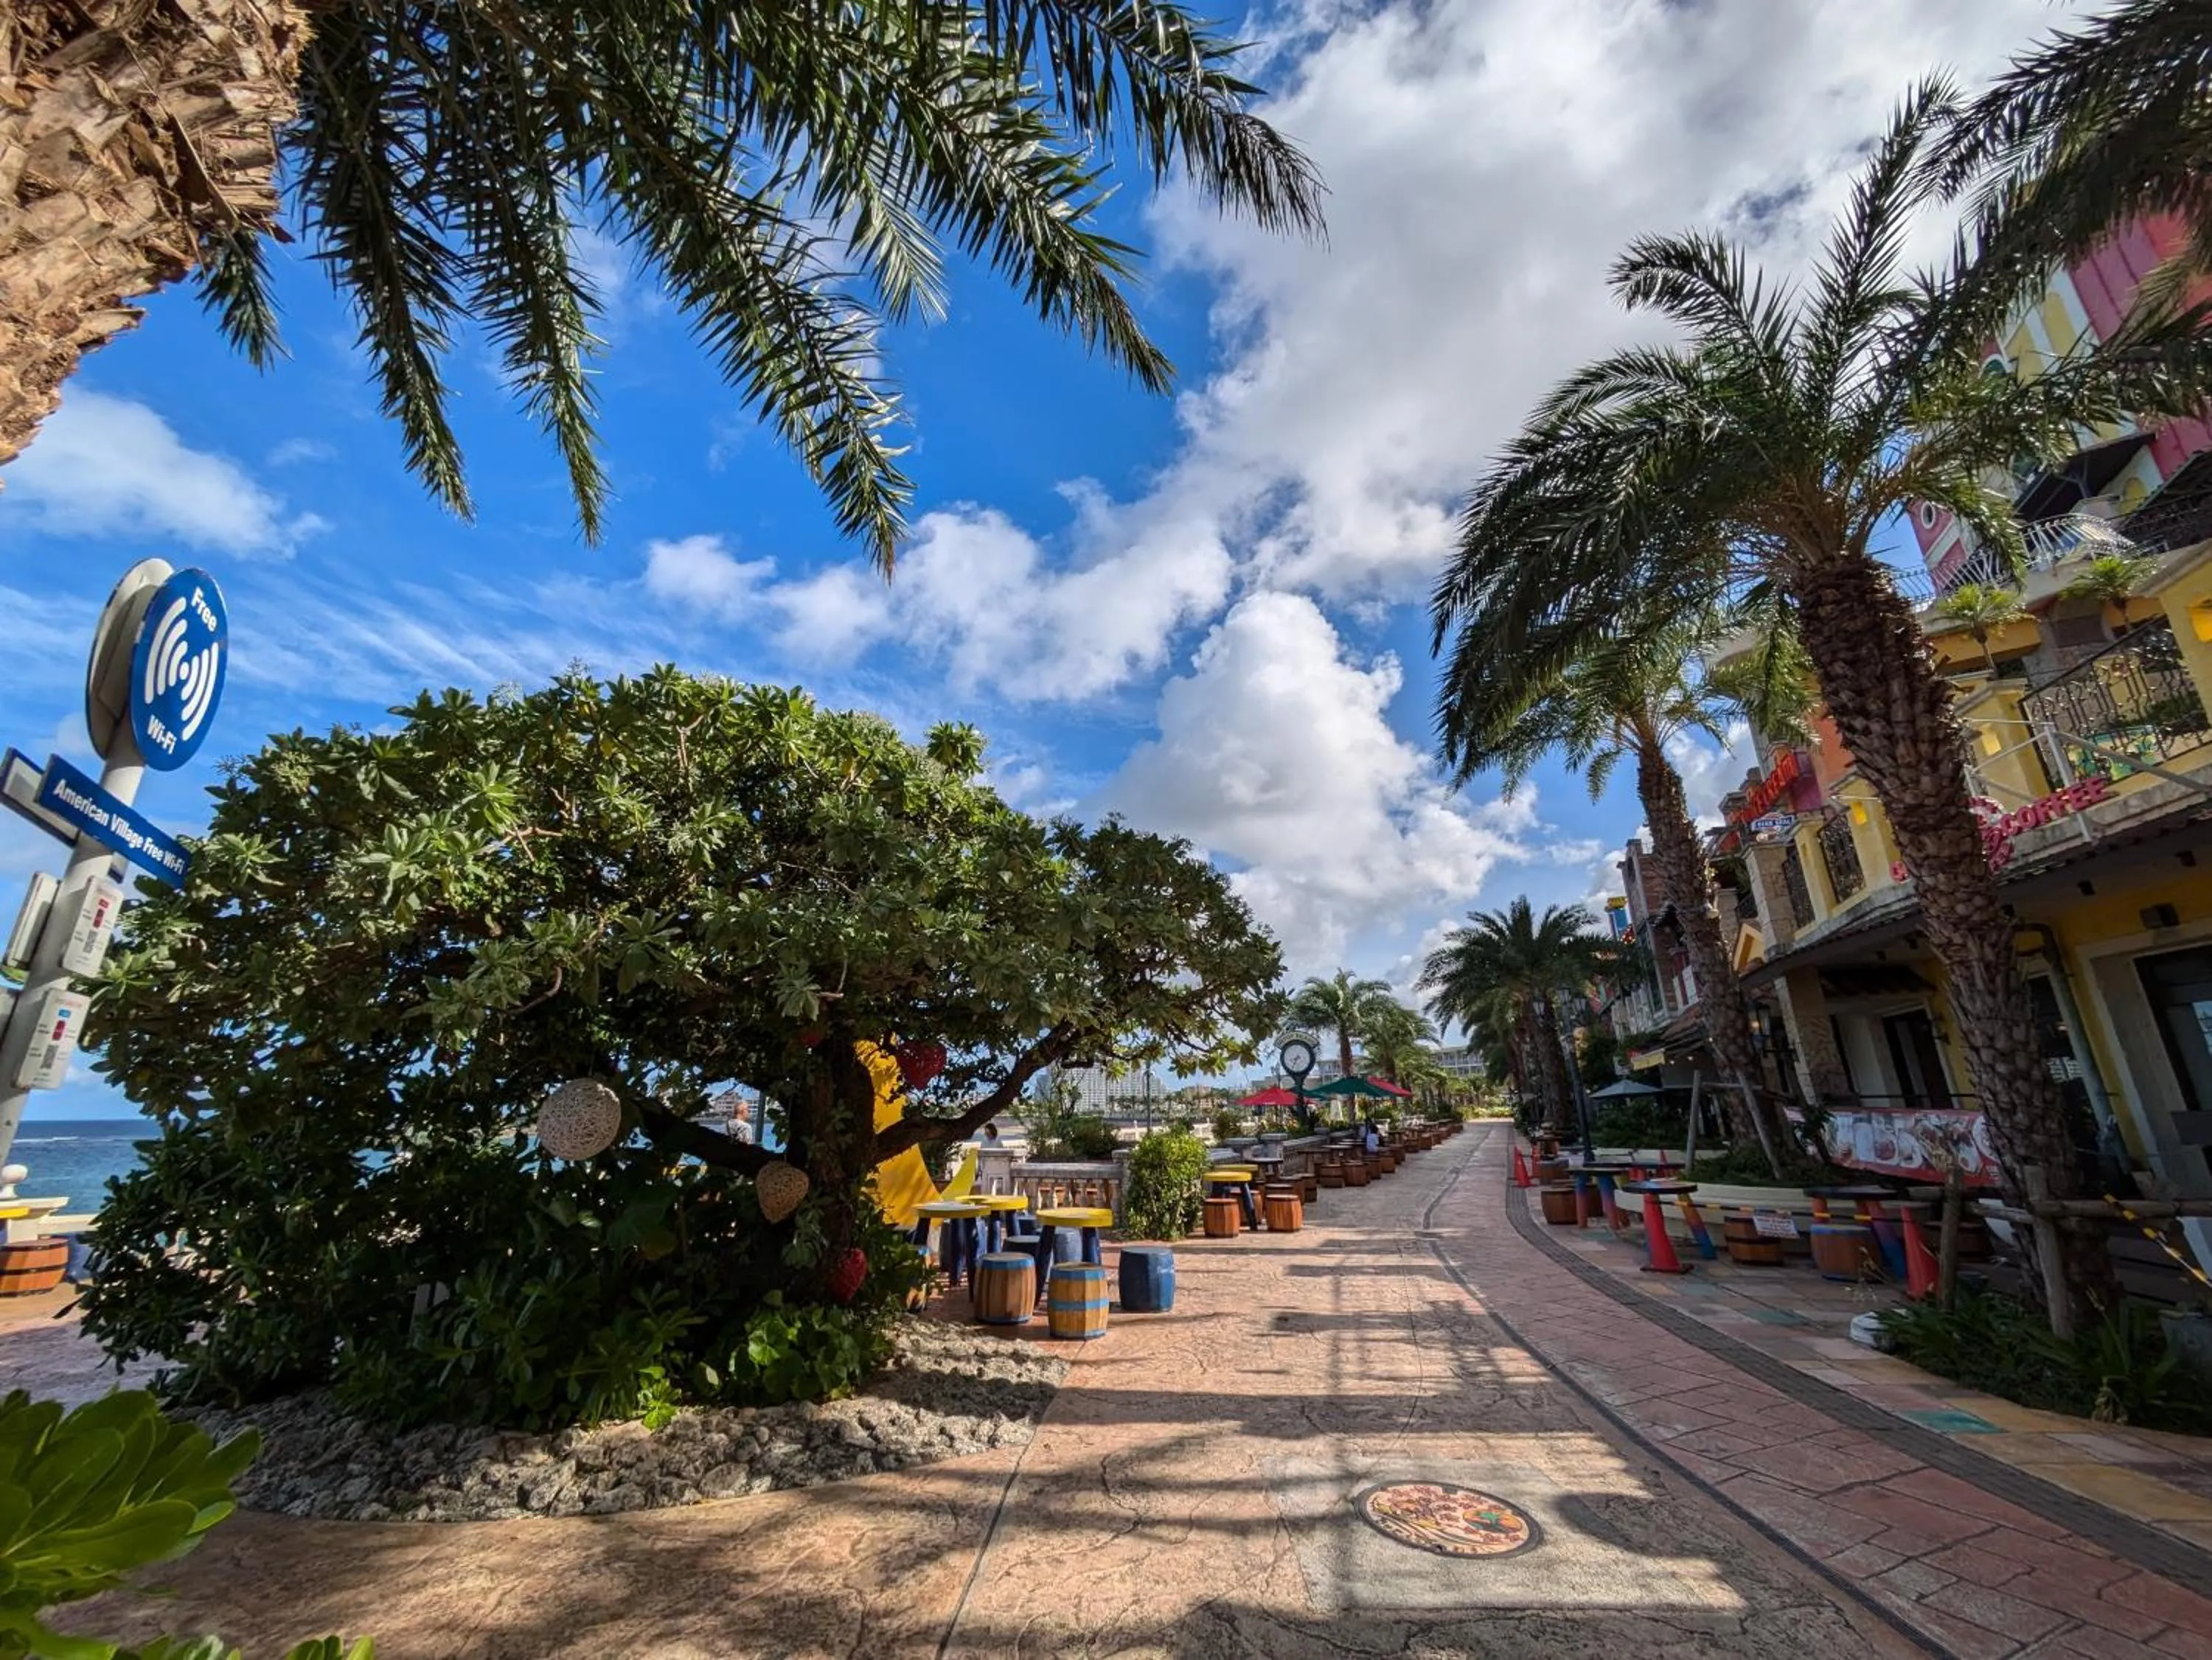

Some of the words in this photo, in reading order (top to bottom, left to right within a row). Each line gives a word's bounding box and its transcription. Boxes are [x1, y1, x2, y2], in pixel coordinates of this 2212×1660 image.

[192, 587, 217, 632] Free
[147, 714, 177, 755] Wi-Fi
[54, 778, 109, 826] American
[111, 814, 144, 848] Village
[143, 837, 164, 861] Free
[163, 851, 184, 875] Wi-Fi
[2000, 777, 2109, 836] COFFEE
